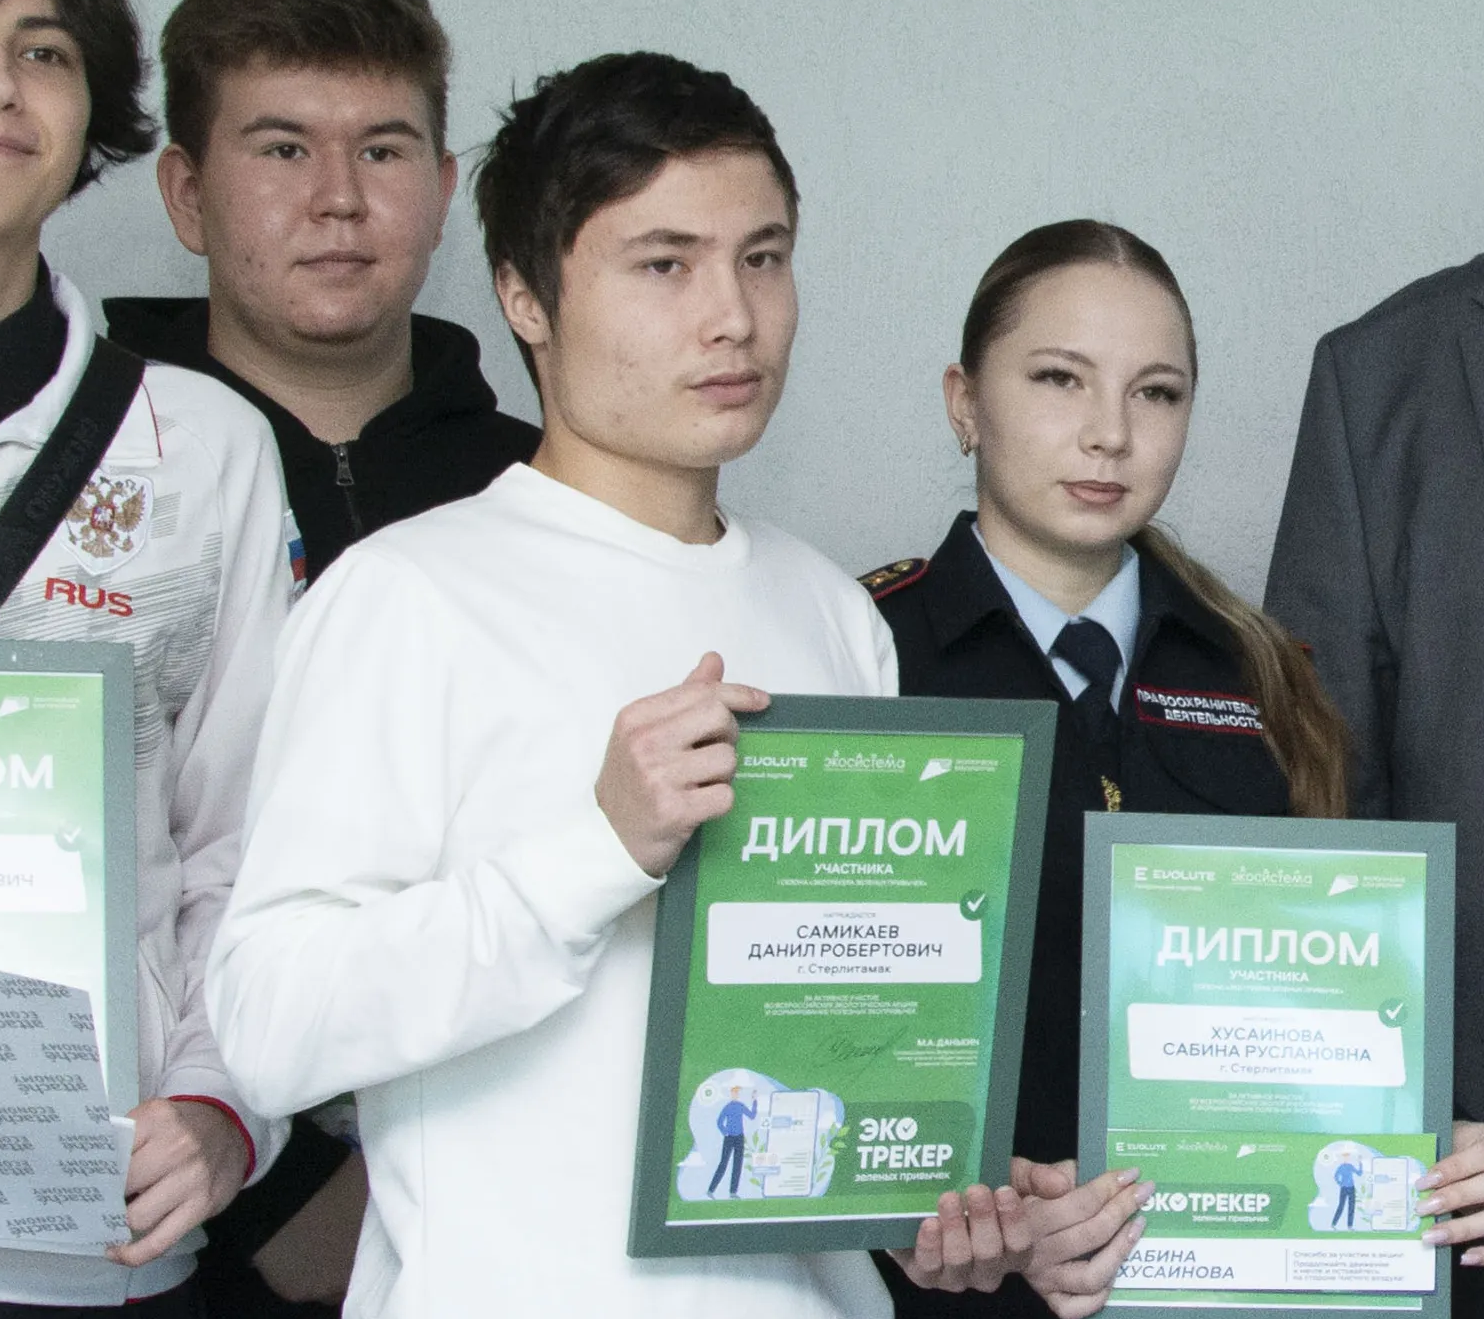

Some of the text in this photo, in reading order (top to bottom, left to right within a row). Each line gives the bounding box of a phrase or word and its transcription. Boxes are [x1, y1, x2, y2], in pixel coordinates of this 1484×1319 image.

[43, 577, 134, 617] RUS
[1136, 689, 1261, 715] ПРАВООХРАНИТЕЛЬ
[1165, 709, 1263, 730] ДЕЯТЕЛЬНОСТЬ
[744, 755, 808, 768] EVOLUTE
[741, 816, 967, 861] ДИПЛОМ
[814, 862, 894, 876] УЧАСТНИКА
[1153, 869, 1215, 882] EVOLUTE
[796, 924, 900, 939] САМИКАЕВ
[748, 943, 943, 960] ДАНИЛ РОБЕРТОВИЧ
[1157, 925, 1380, 968] ДИПЛОМ
[809, 962, 892, 976] Стерлитамак
[1230, 969, 1309, 983] УЧАСТНИКА
[1211, 1026, 1324, 1043] ХУСАИНОВА
[1163, 1042, 1371, 1062] САБИНА РУСЛАНОВНА
[15, 1074, 83, 1084] ECONOMY
[18, 1081, 88, 1095] attaché
[859, 1117, 917, 1142] ЭКО
[856, 1144, 953, 1169] ТРЕКЕР
[1125, 1249, 1196, 1262] АБИНА
[1116, 1265, 1234, 1279] ХУСАИНОВА
